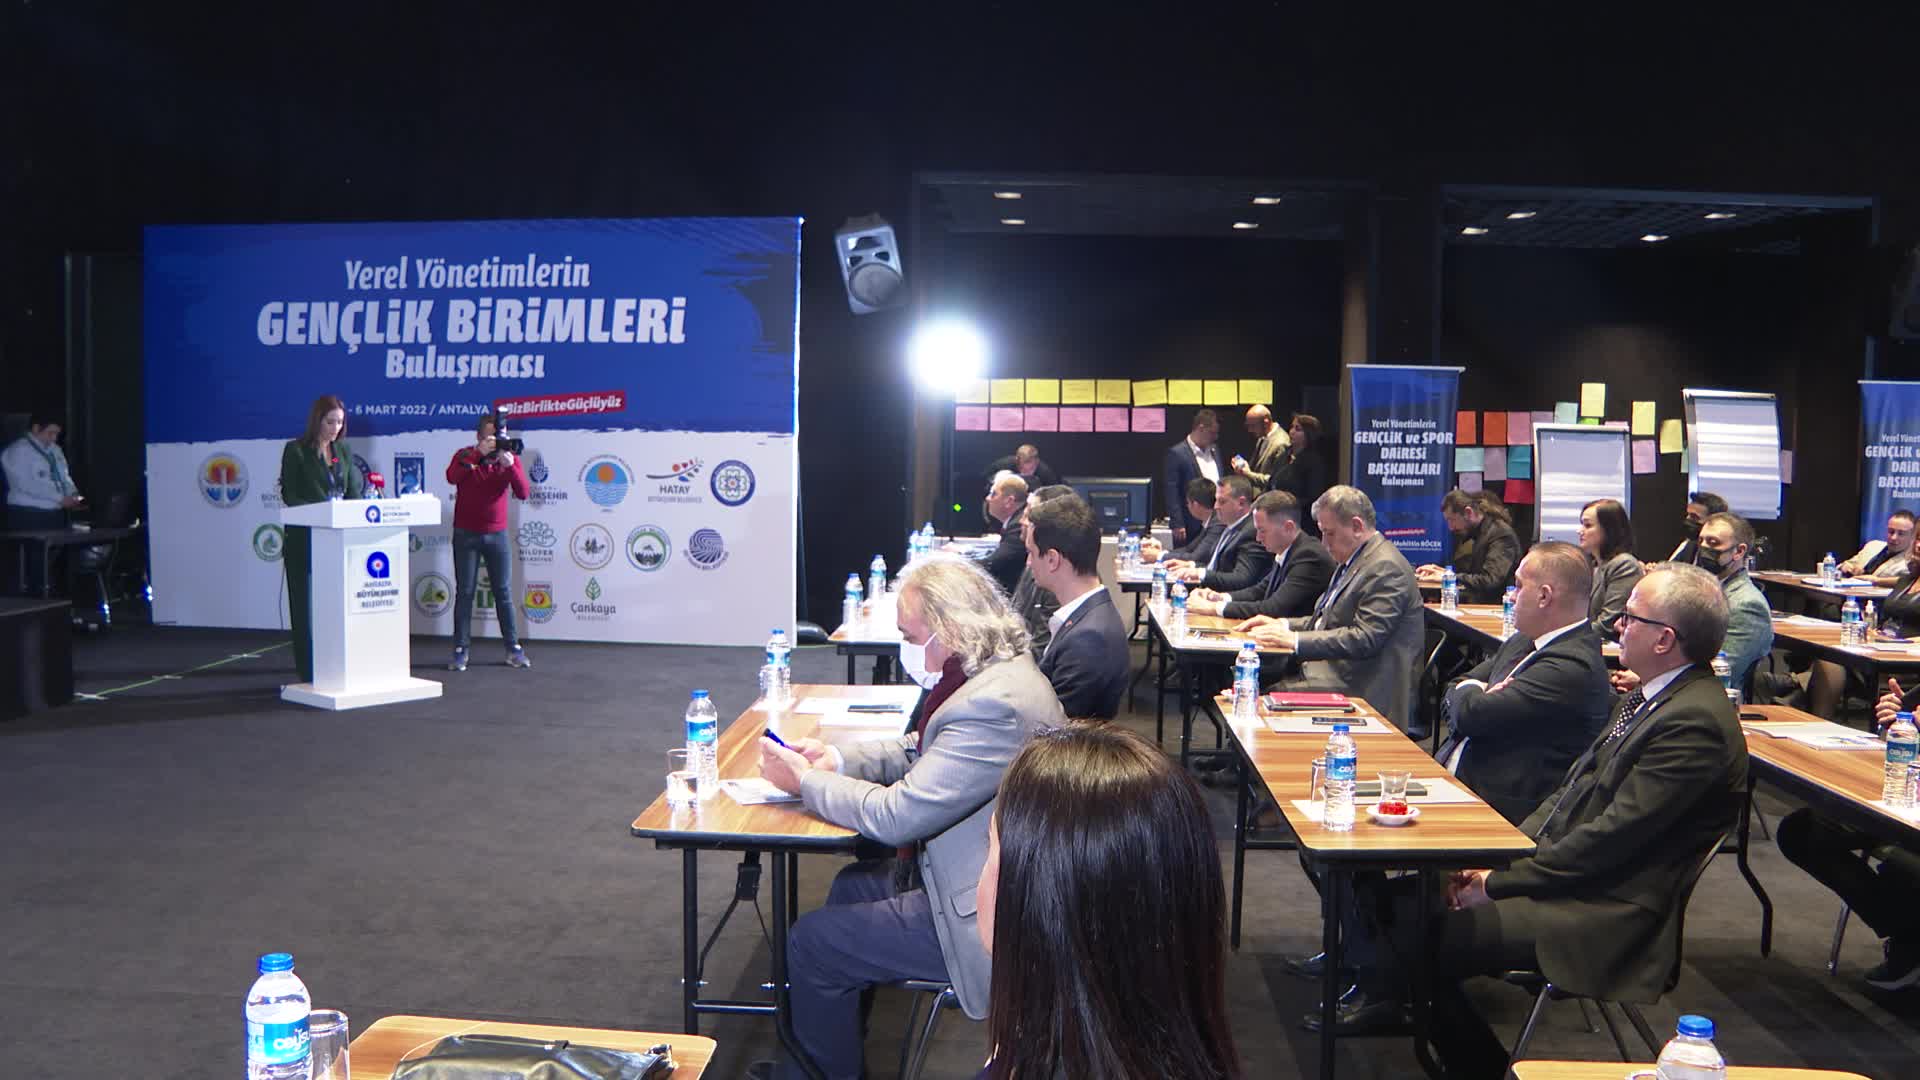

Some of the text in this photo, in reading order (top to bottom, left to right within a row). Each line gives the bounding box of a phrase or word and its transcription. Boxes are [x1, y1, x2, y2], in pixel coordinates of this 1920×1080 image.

[344, 254, 590, 290] Yerel Yönetimlerin
[385, 345, 545, 385] Buluşması
[355, 405, 363, 415] 6
[365, 404, 396, 415] MART
[399, 404, 427, 415] 2022
[438, 404, 490, 415] ANTALYA
[498, 395, 622, 415] BizBirlikteGüçlüyüz
[1405, 434, 1420, 444] ve
[1422, 431, 1454, 445] SPOR
[1367, 462, 1441, 477] BAŞKANLARI
[659, 485, 691, 495] HATAY
[570, 602, 617, 616] Çankaya
